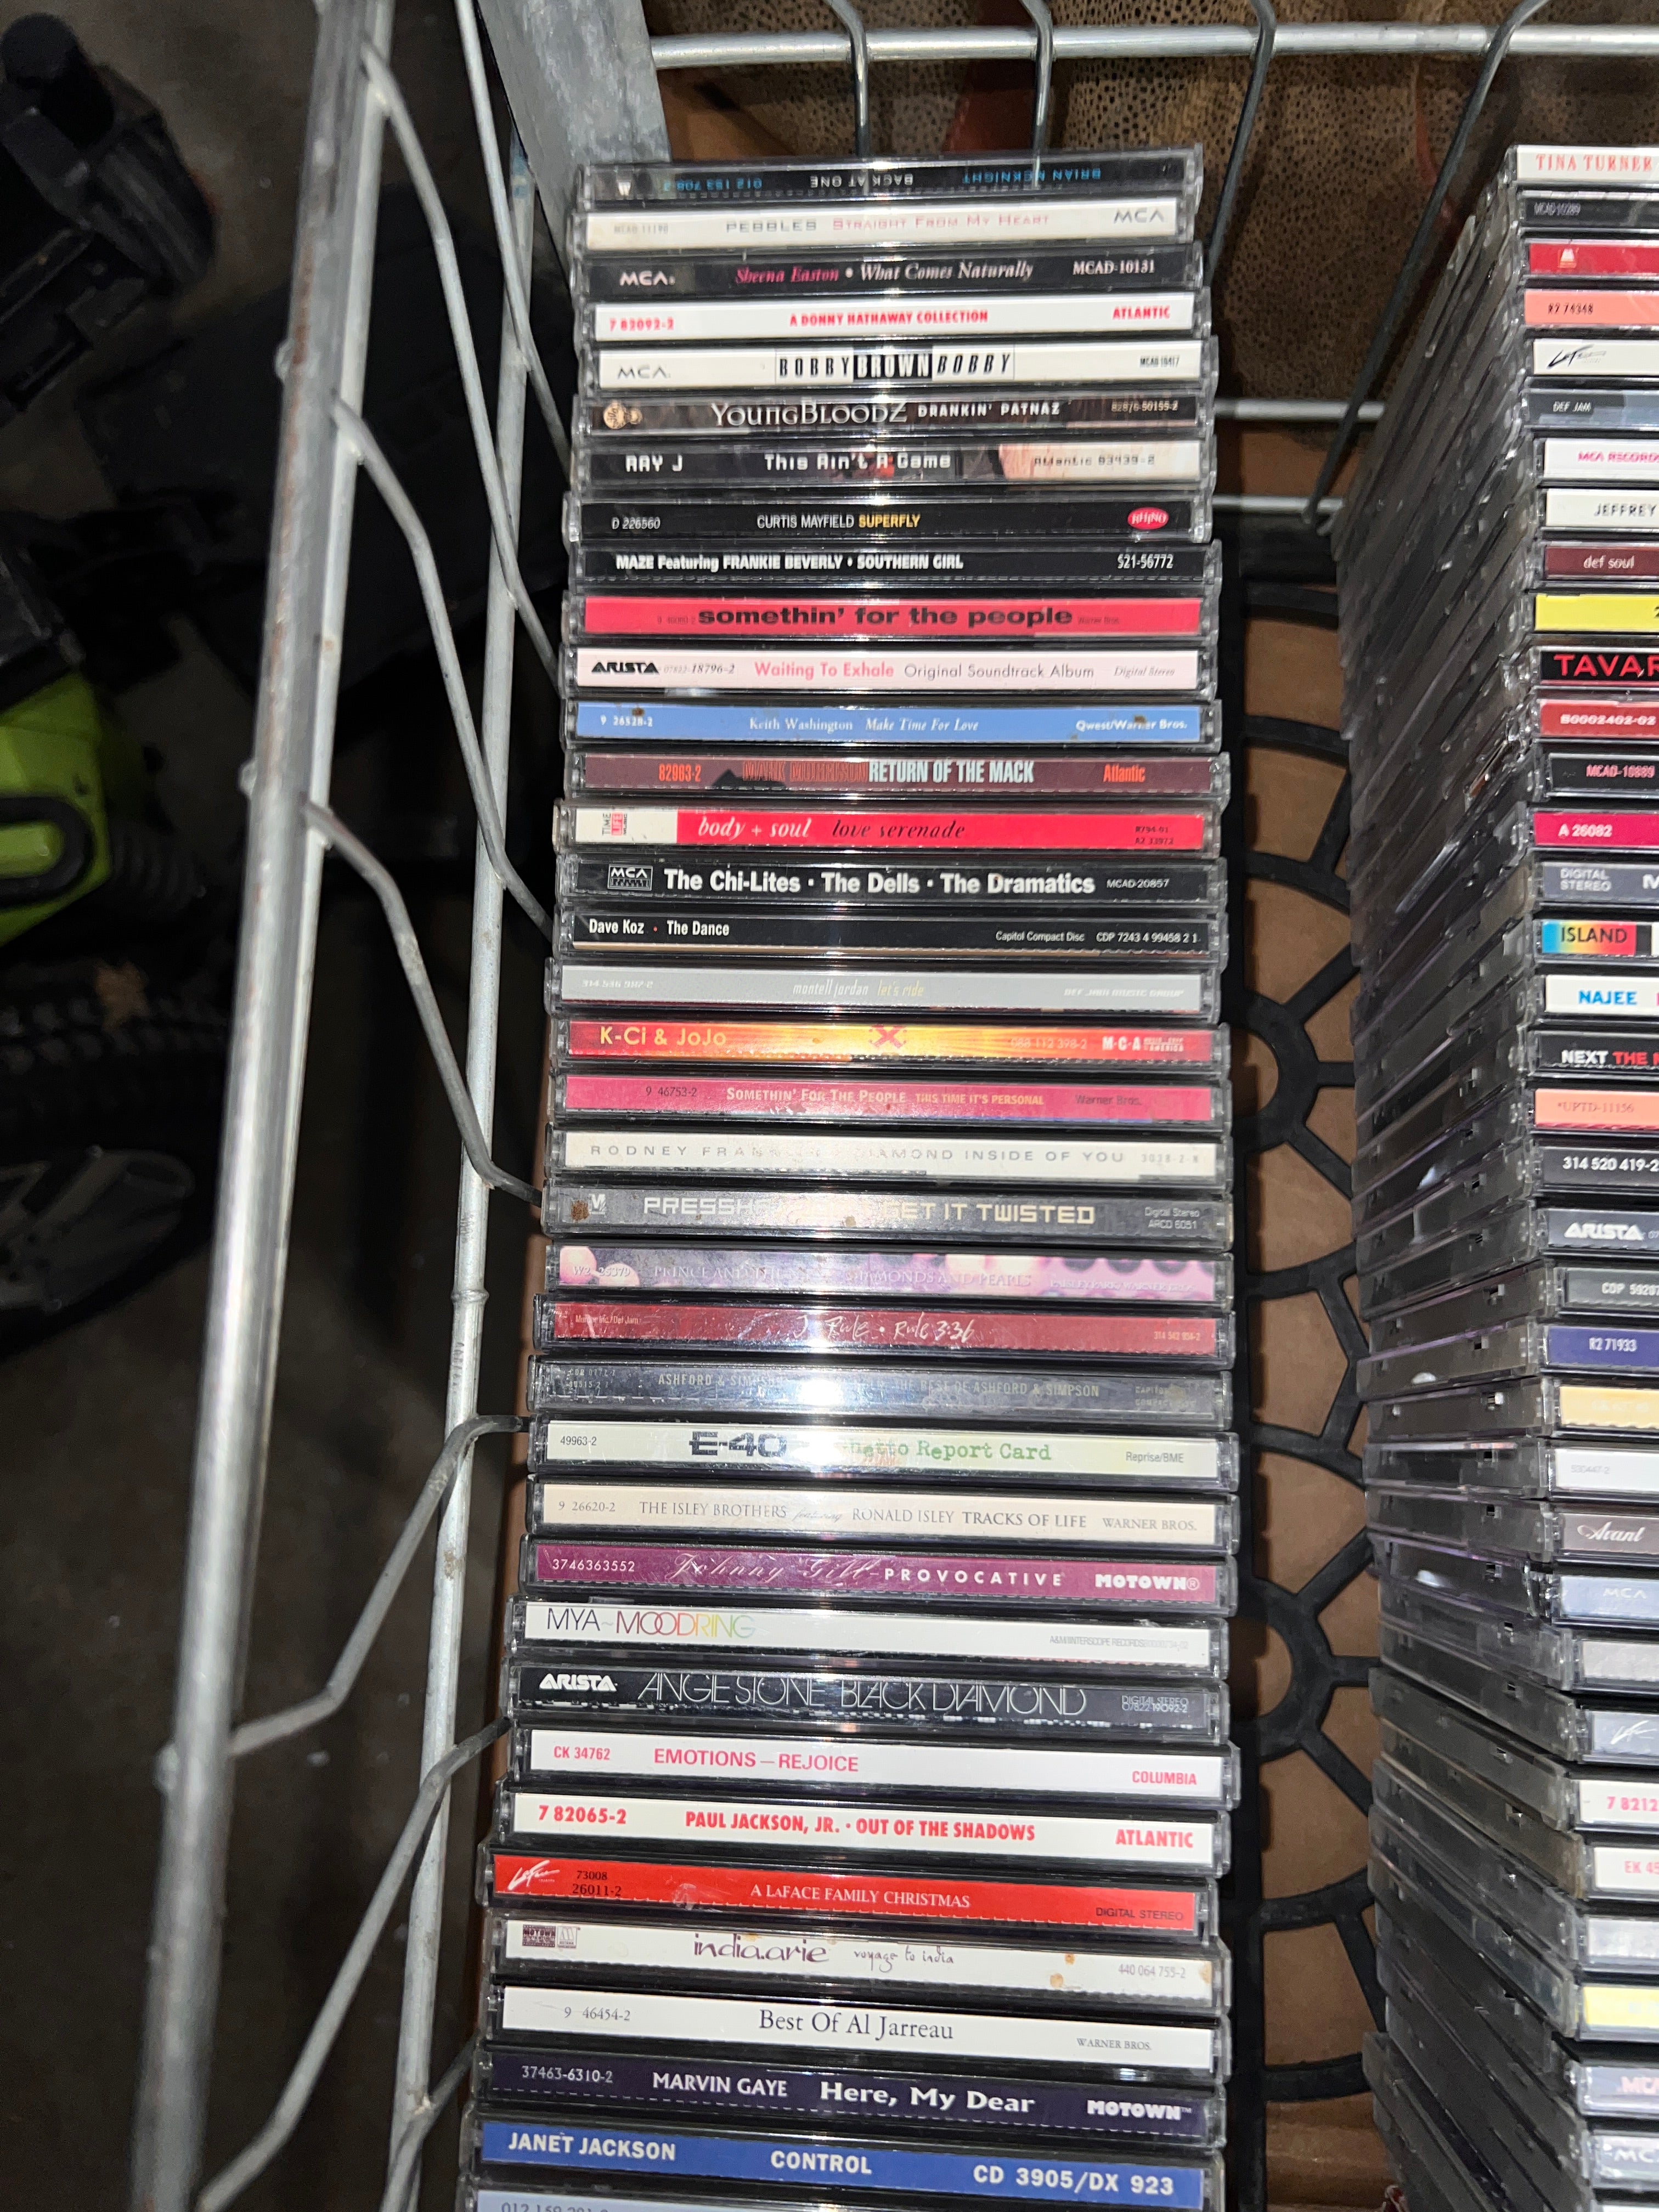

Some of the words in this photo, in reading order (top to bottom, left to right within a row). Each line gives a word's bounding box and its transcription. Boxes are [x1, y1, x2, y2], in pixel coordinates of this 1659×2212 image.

[1536, 154, 1577, 171] TINA
[1583, 154, 1652, 171] TURNER
[810, 175, 842, 188] ONE
[1053, 168, 1101, 180] BRIAN
[727, 221, 817, 233] PEBBLES
[957, 260, 1034, 280] Naturally
[802, 314, 843, 326] DONNY
[848, 311, 912, 325] HATHAWAY
[917, 309, 988, 324] COLLECTION
[1113, 307, 1170, 319] ATLANTIC
[780, 357, 850, 377] BOBBY
[937, 354, 1011, 375] BOBBY
[1553, 402, 1571, 411] DEF
[765, 454, 808, 471] This
[1594, 504, 1656, 516] JEFFREY
[623, 517, 661, 530] 226560
[757, 515, 797, 529] CURTIS
[801, 515, 854, 528] MAYFIELD
[859, 513, 921, 528] SUPERFLY
[616, 555, 654, 569] MAZE
[658, 555, 719, 572] Featuring
[723, 555, 781, 569] FRANKIE
[785, 555, 843, 569] BEVERLY
[856, 554, 929, 569] SOUTHERN
[933, 554, 963, 569] GIRL
[1584, 556, 1604, 568] def
[1608, 556, 1634, 568] soul
[910, 607, 958, 625] the
[968, 607, 1073, 628] people
[591, 662, 659, 675] ARISTA
[755, 661, 815, 680] Waiting
[820, 661, 838, 677] To
[844, 661, 894, 678] Exhale
[904, 664, 962, 680] Original
[968, 663, 1043, 678] Soundtrack
[1050, 663, 1094, 678] Album
[1114, 666, 1146, 678] Digital
[785, 719, 853, 733] Washington
[954, 718, 979, 731] Love
[1560, 715, 1656, 725] B0002402-02
[869, 760, 928, 783] RETURN
[933, 760, 952, 782] OF
[956, 760, 984, 782] THE
[990, 760, 1034, 782] MACK
[1103, 764, 1146, 782] Atlantic
[698, 817, 746, 840] body
[769, 819, 812, 837] soul
[832, 820, 870, 837] love
[879, 820, 966, 839] serenade
[664, 869, 702, 890] The
[710, 870, 800, 891] Chi-Lites
[821, 872, 860, 892] The
[868, 872, 920, 894] Dells
[940, 873, 980, 893] The
[988, 873, 1095, 893] Dramatics
[1560, 868, 1609, 880] DIGITAL
[1560, 880, 1611, 891] STEREO
[589, 919, 619, 934] Dave
[623, 919, 644, 934] Koz
[667, 921, 689, 935] The
[692, 921, 730, 935] Dance
[996, 932, 1024, 941] Capitol
[1027, 932, 1063, 943] Compact
[1066, 932, 1084, 941] Disc
[1151, 933, 1180, 943] 99458
[1561, 927, 1627, 944] ISLAND
[1579, 991, 1637, 1005] NAJEE
[600, 1027, 646, 1045] K-Ci
[677, 1028, 726, 1046] JoJo
[1562, 1050, 1607, 1064] NEXT
[1613, 1052, 1648, 1065] THE
[658, 1087, 697, 1097] 46753-2
[991, 1094, 1045, 1105] PERSONAL
[591, 1146, 687, 1156] RODNEY
[965, 1150, 1034, 1161] INSIDE
[1046, 1152, 1070, 1161] OF
[1083, 1152, 1124, 1162] YOU
[1563, 1157, 1588, 1170] 314
[1592, 1158, 1617, 1170] 520
[976, 1204, 1095, 1224] TWISTED
[1144, 1207, 1170, 1218] Digital
[1565, 1223, 1643, 1240] ARISTA
[934, 1320, 974, 1343] 3:36
[1605, 1339, 1637, 1351] 71933
[659, 1374, 712, 1385] ASHFORD
[973, 1383, 1027, 1395] ASHFORD
[1045, 1385, 1098, 1396] SIMPSON
[560, 1436, 597, 1446] 49963-2
[689, 1431, 787, 1457] E-40
[917, 1440, 991, 1460] Report
[1000, 1444, 1052, 1460] Card
[1126, 1452, 1184, 1463] Reprise/BME
[572, 1501, 616, 1512] 26620-2
[640, 1501, 668, 1514] THE
[672, 1502, 709, 1515] ISLEY
[713, 1504, 787, 1519] BROTHERS
[852, 1507, 913, 1522] RONALD
[918, 1511, 953, 1523] ISLEY
[962, 1512, 1023, 1526] TRACKS
[1028, 1514, 1049, 1526] OF
[1054, 1515, 1087, 1528] LIFE
[1103, 1519, 1158, 1530] WARNER
[552, 1559, 635, 1572] 3746363552
[885, 1568, 1062, 1587] PROVOCATIVE
[548, 1609, 601, 1631] MYA
[617, 1610, 755, 1638] MOODRING
[539, 1674, 617, 1692] ARISTA
[554, 1746, 570, 1758] CK
[574, 1747, 610, 1760] 34762
[654, 1748, 756, 1767] EMOTIONS
[778, 1754, 859, 1772] REJOICE
[1132, 1771, 1197, 1785] COLUMBIA
[538, 1805, 549, 1820] 7
[554, 1806, 626, 1824] 82065-2
[686, 1812, 726, 1828] PAUL
[731, 1813, 808, 1833] JACKSON,
[856, 1819, 888, 1835] OUT
[894, 1820, 913, 1836] OF
[920, 1821, 947, 1837] THE
[953, 1822, 1035, 1841] SHADOWS
[1115, 1829, 1194, 1848] ATLANTIC
[577, 1871, 607, 1880] 73008
[572, 1883, 622, 1897] 26011-2
[825, 1887, 879, 1903] FAMILY
[883, 1892, 970, 1908] CHRISTMAS
[1096, 1908, 1136, 1918] DIGITAL
[1139, 1910, 1184, 1920] STEREO
[854, 1950, 899, 1973] voyage
[922, 1946, 955, 1964] india
[582, 2007, 631, 2021] 46454-2
[759, 2010, 803, 2030] Best
[812, 2011, 842, 2032] Of
[848, 2013, 870, 2035] Al
[876, 2016, 953, 2040] Jarreau
[1077, 2038, 1121, 2049] WARNER
[522, 2066, 613, 2083] 37463-6310-2
[653, 2073, 730, 2094] MARVIN
[737, 2078, 787, 2097] GAYE
[910, 2087, 955, 2111] My
[967, 2091, 1035, 2113] Dear
[509, 2132, 573, 2154] JANET
[579, 2137, 675, 2161] JACKSON
[770, 2149, 872, 2175] CONTROL
[974, 2165, 1004, 2184] CD
[1016, 2167, 1119, 2193] 3905/DX
[1131, 2175, 1173, 2195] 923
